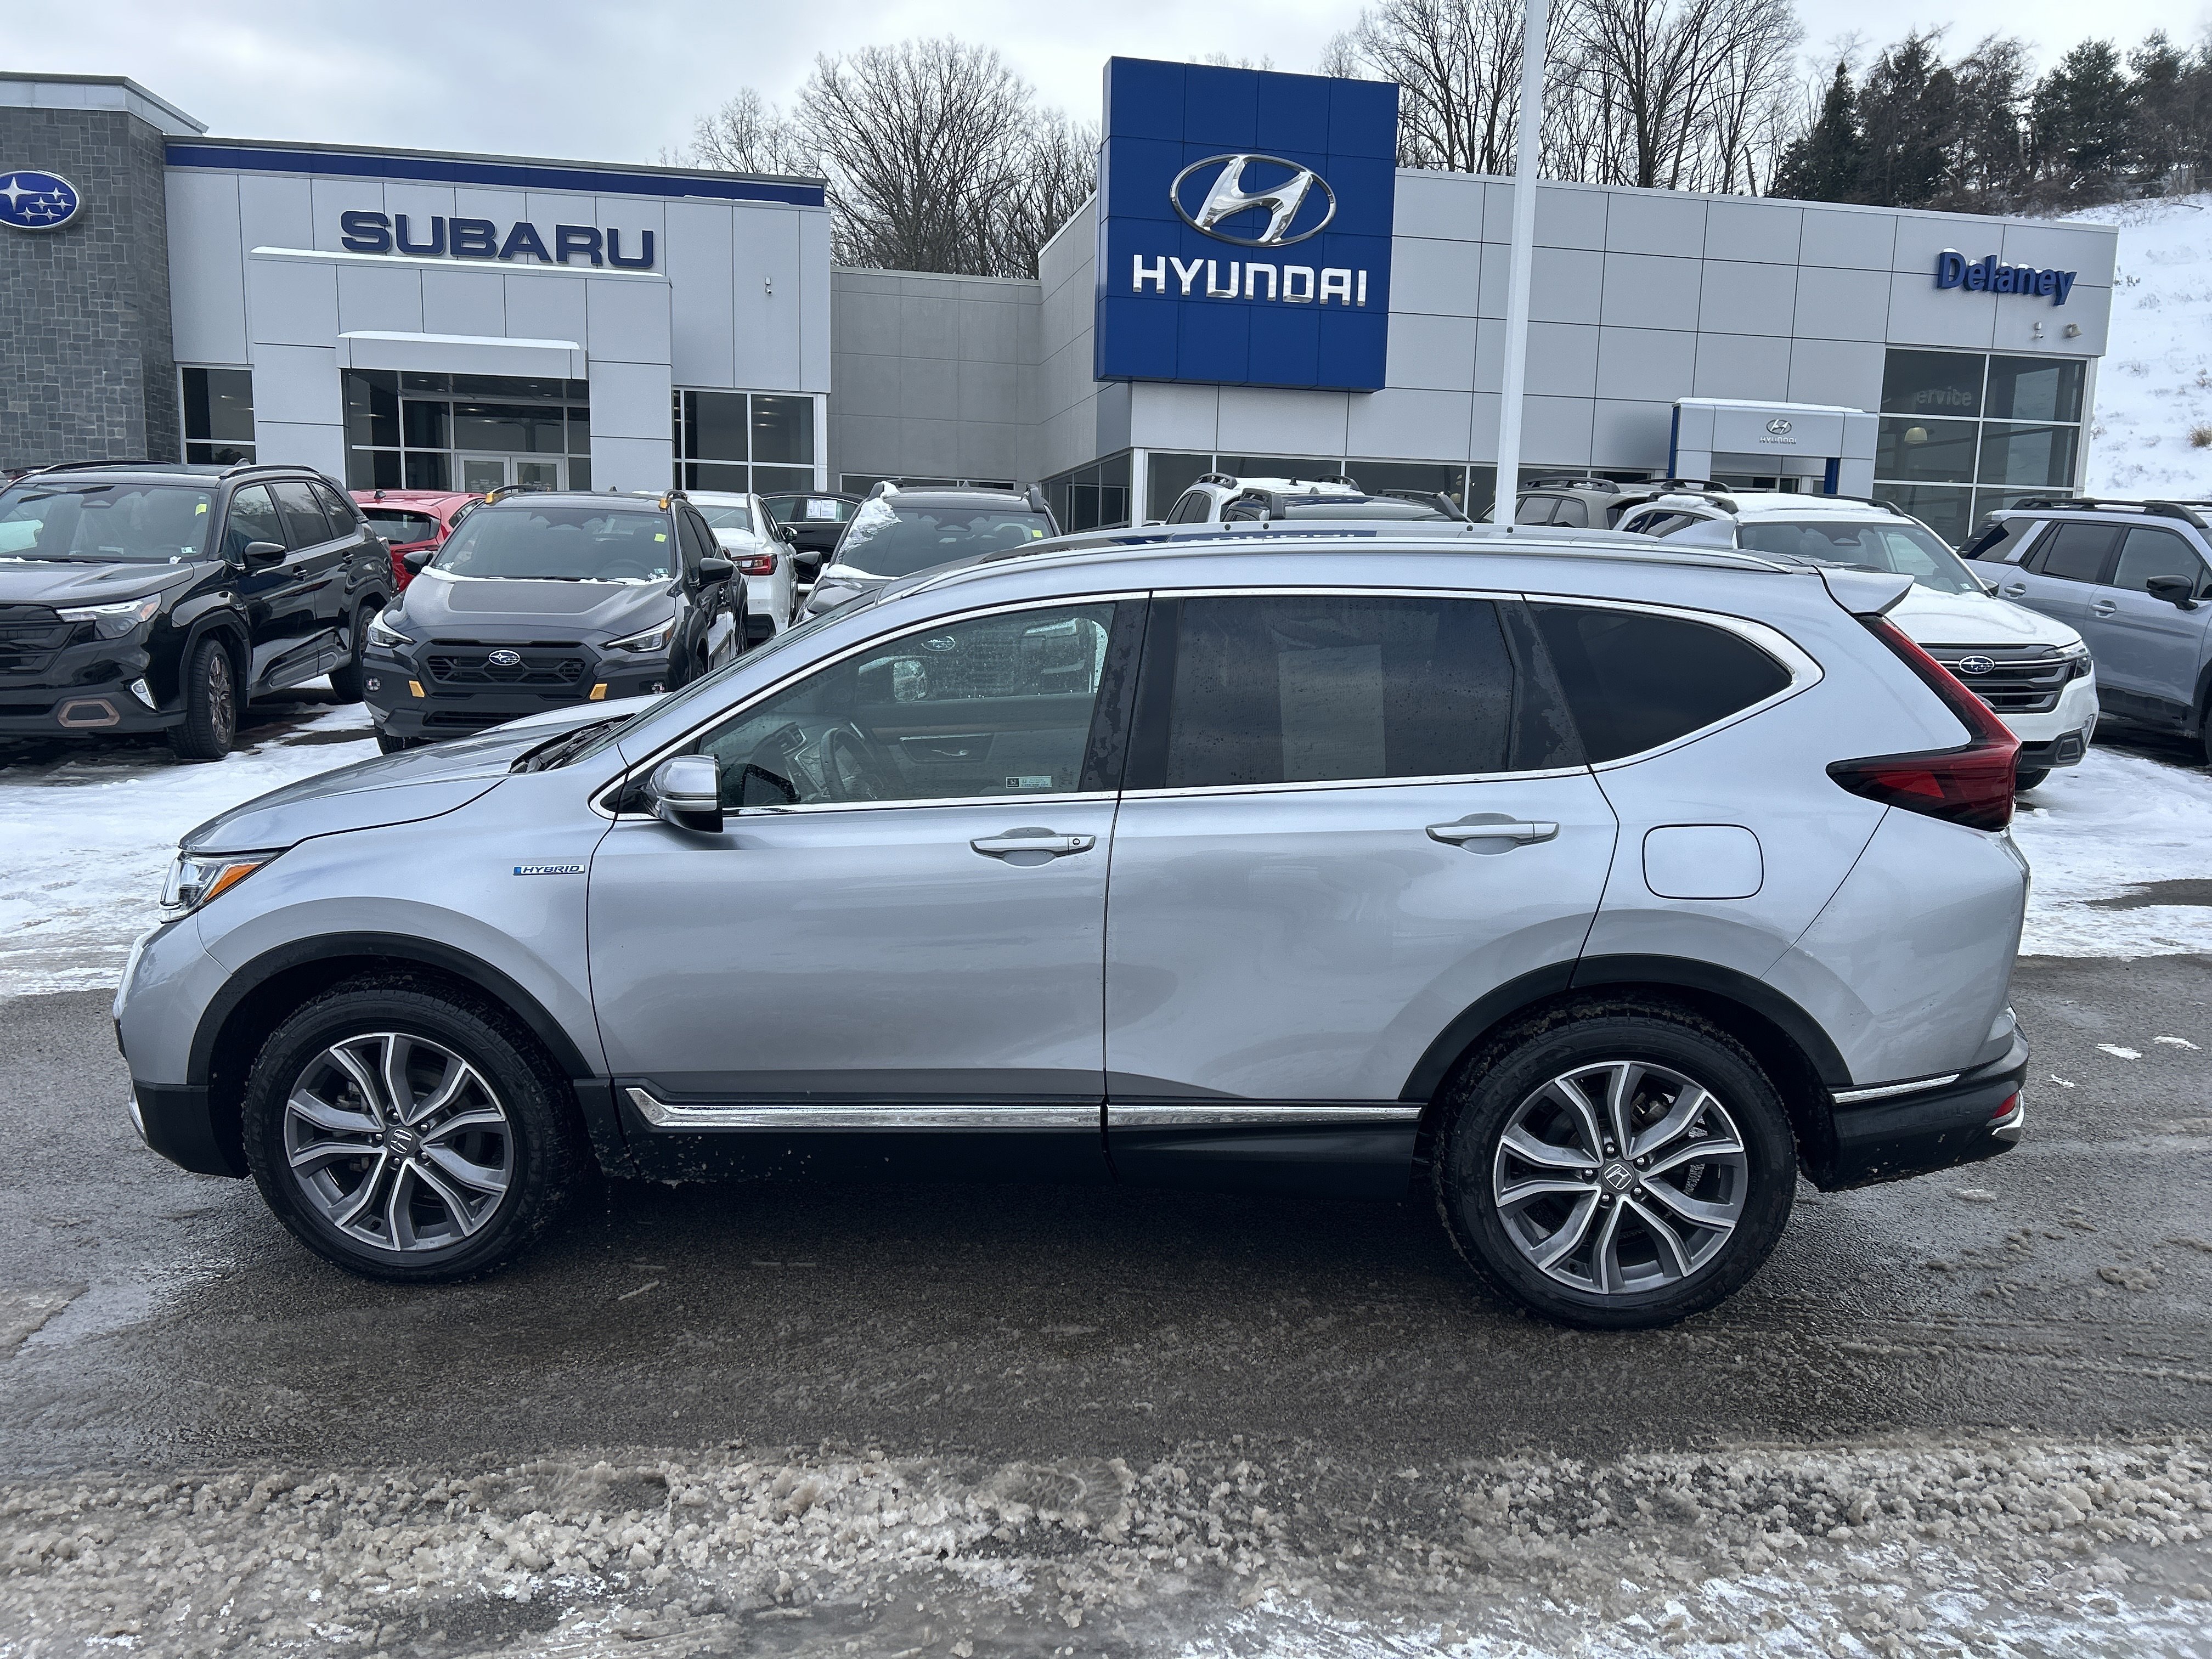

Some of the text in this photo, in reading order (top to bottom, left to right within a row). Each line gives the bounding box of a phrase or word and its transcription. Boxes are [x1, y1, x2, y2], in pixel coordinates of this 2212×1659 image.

[340, 210, 655, 268] SUBARU
[1132, 254, 1367, 307] HYUNDAI
[1937, 250, 2078, 306] Delaney
[1916, 386, 1972, 407] ervice
[1759, 436, 1797, 444] HYUNDAI
